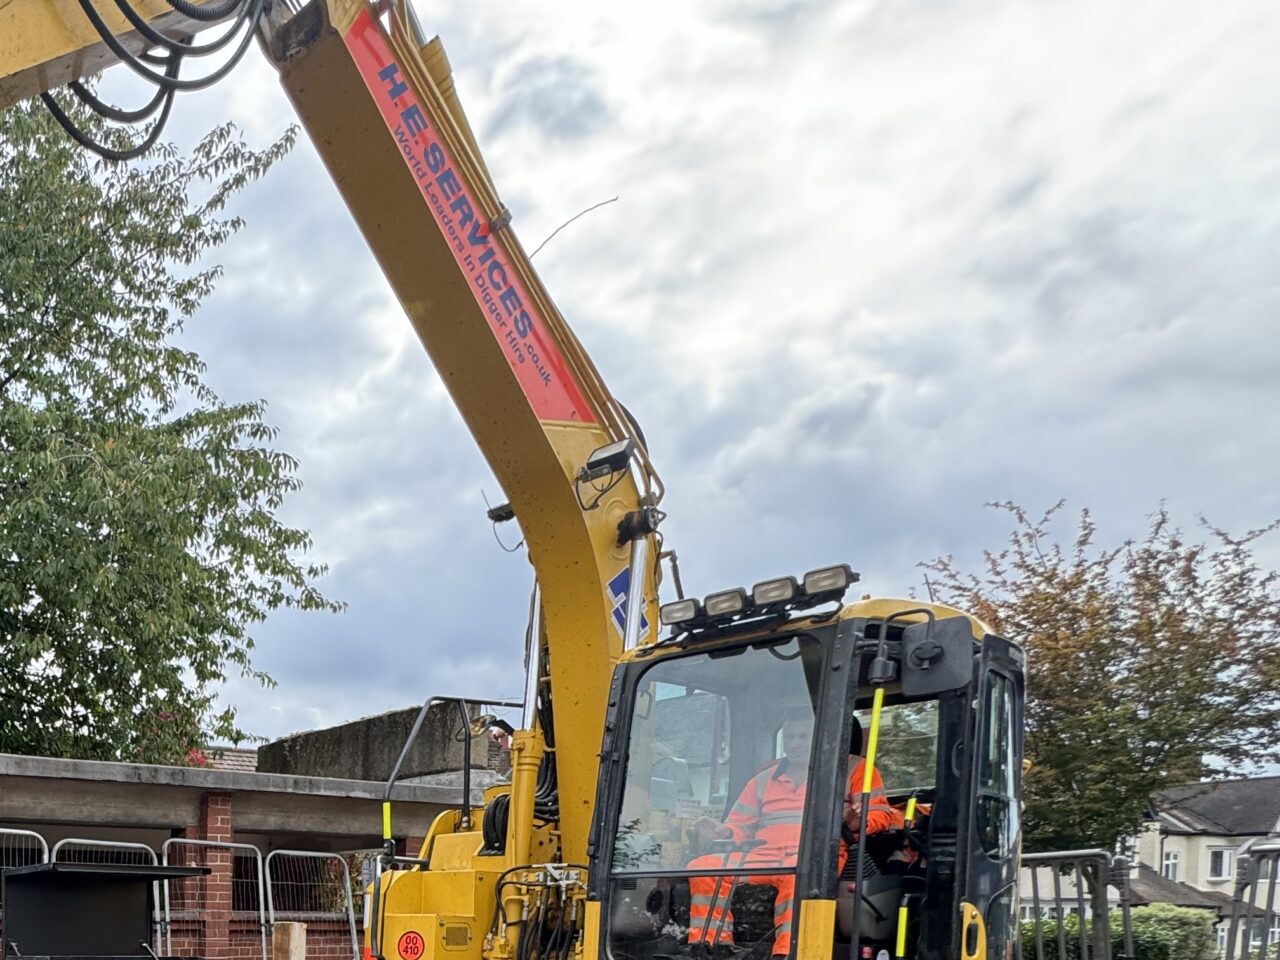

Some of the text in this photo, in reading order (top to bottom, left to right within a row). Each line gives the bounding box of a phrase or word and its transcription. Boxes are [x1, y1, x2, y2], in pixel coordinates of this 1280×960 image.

[394, 124, 427, 180] World
[424, 182, 464, 252] Leaders
[475, 273, 508, 328] Digger
[505, 331, 526, 364] Hire
[402, 945, 419, 955] 410
